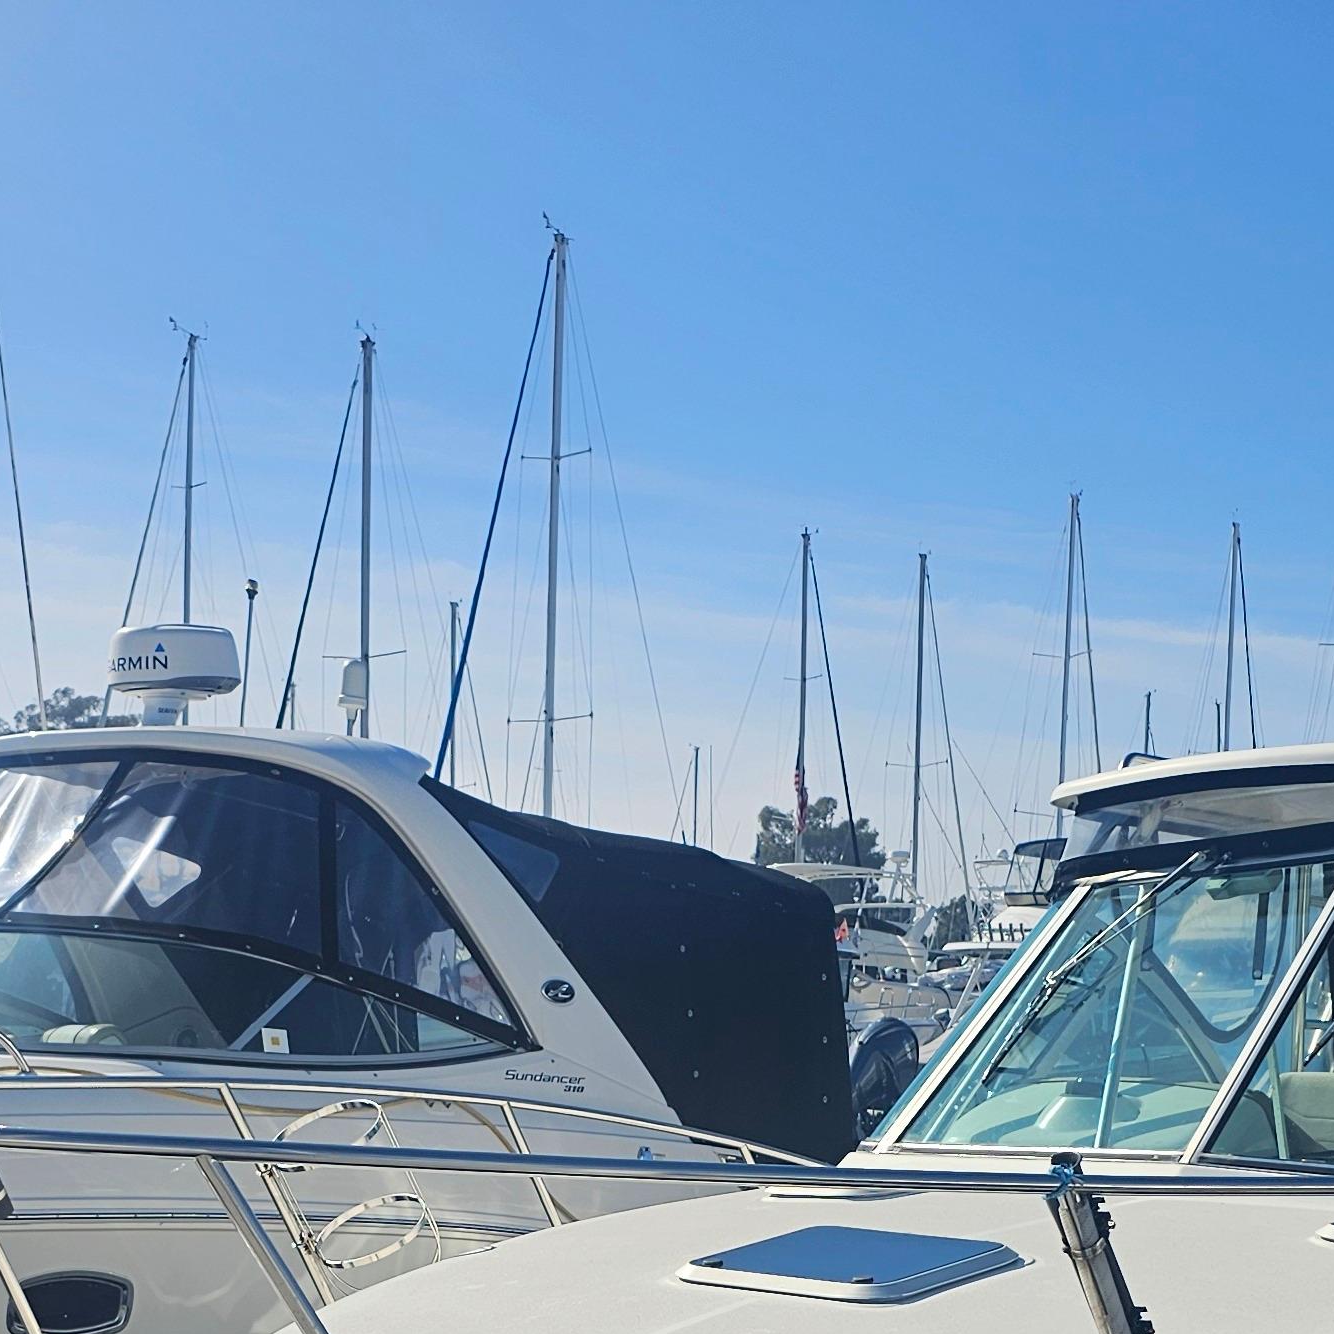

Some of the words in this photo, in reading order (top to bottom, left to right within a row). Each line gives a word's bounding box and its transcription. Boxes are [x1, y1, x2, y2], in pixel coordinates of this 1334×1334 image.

[108, 655, 168, 672] ARMIN
[505, 1069, 586, 1085] Sundancer
[563, 1085, 585, 1093] 310
